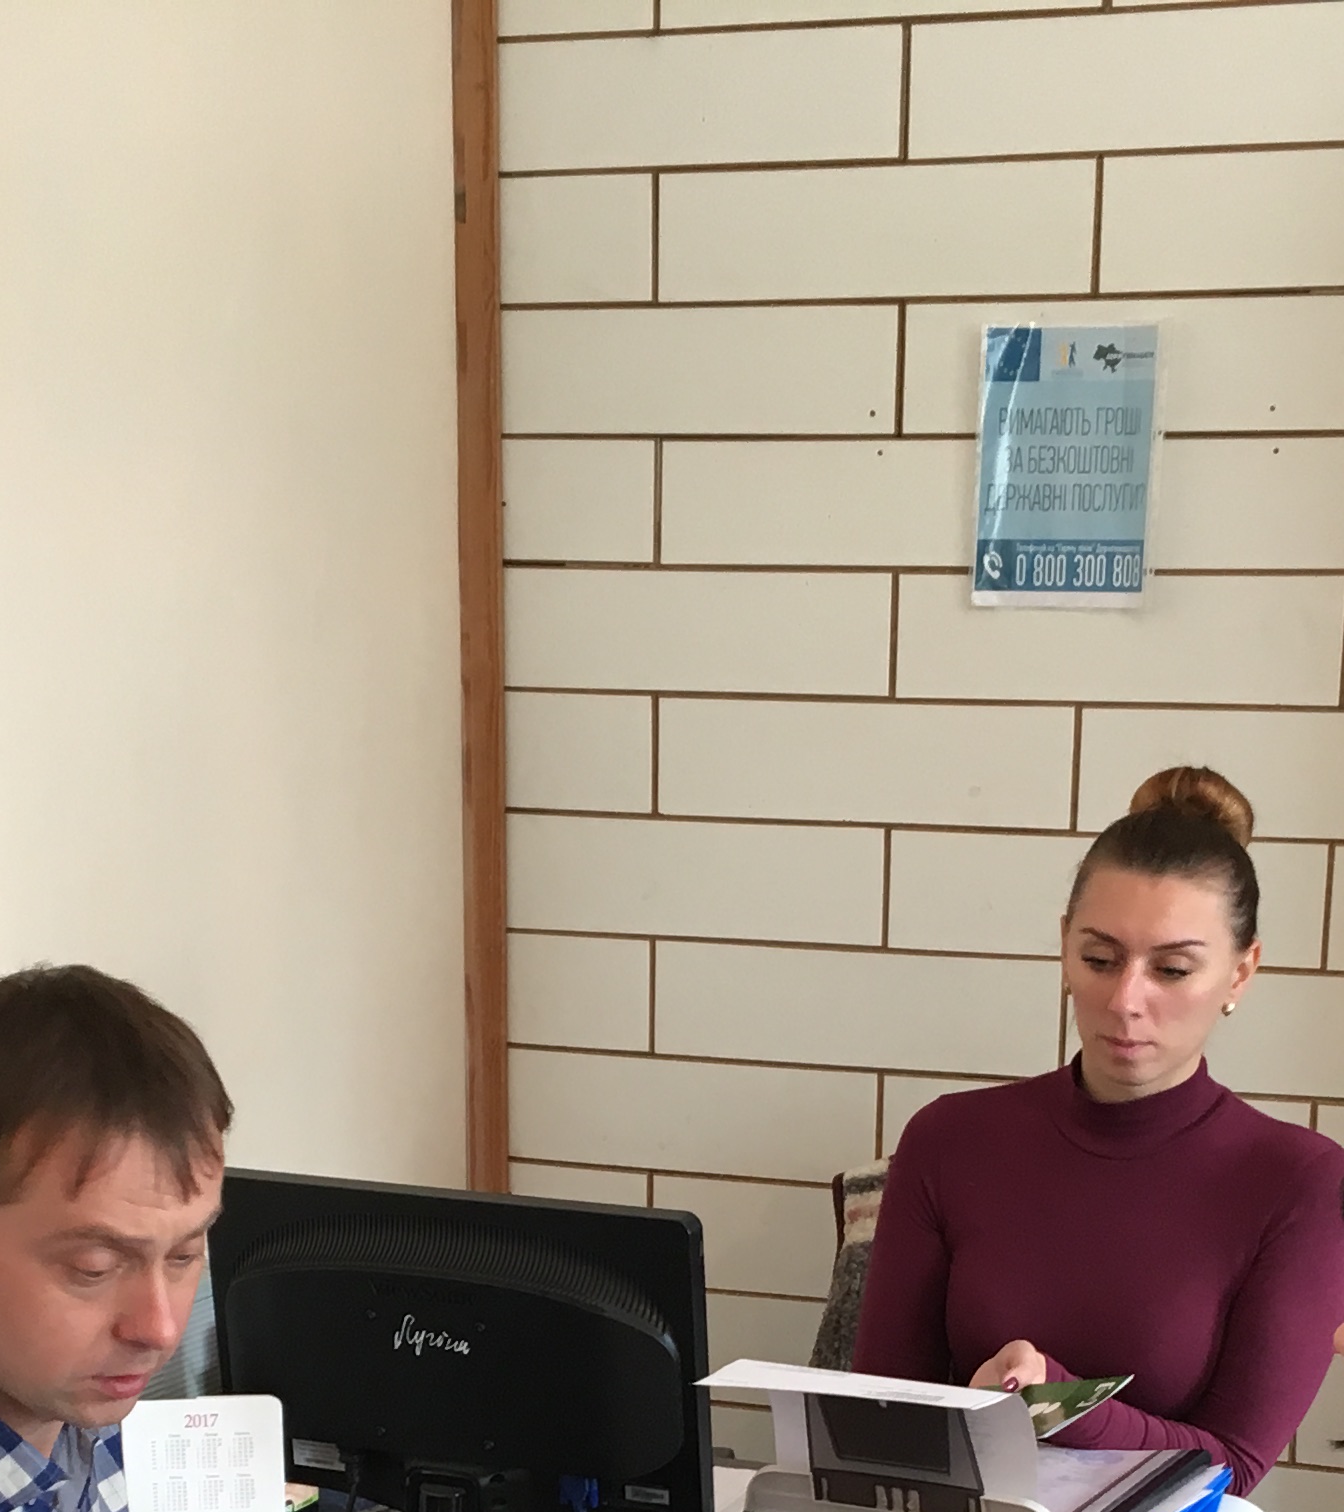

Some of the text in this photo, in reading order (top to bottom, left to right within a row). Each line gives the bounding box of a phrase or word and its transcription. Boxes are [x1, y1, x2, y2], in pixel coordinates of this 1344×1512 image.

[998, 406, 1142, 436] ВИМАГАЮТЬ ГРОШІ
[1027, 445, 1134, 474] БЕЗКОШТОВНІ
[1072, 483, 1146, 512] ПОСЛУГИ?
[1016, 554, 1141, 587] 0 800 300 808
[184, 1413, 219, 1429] 2017
